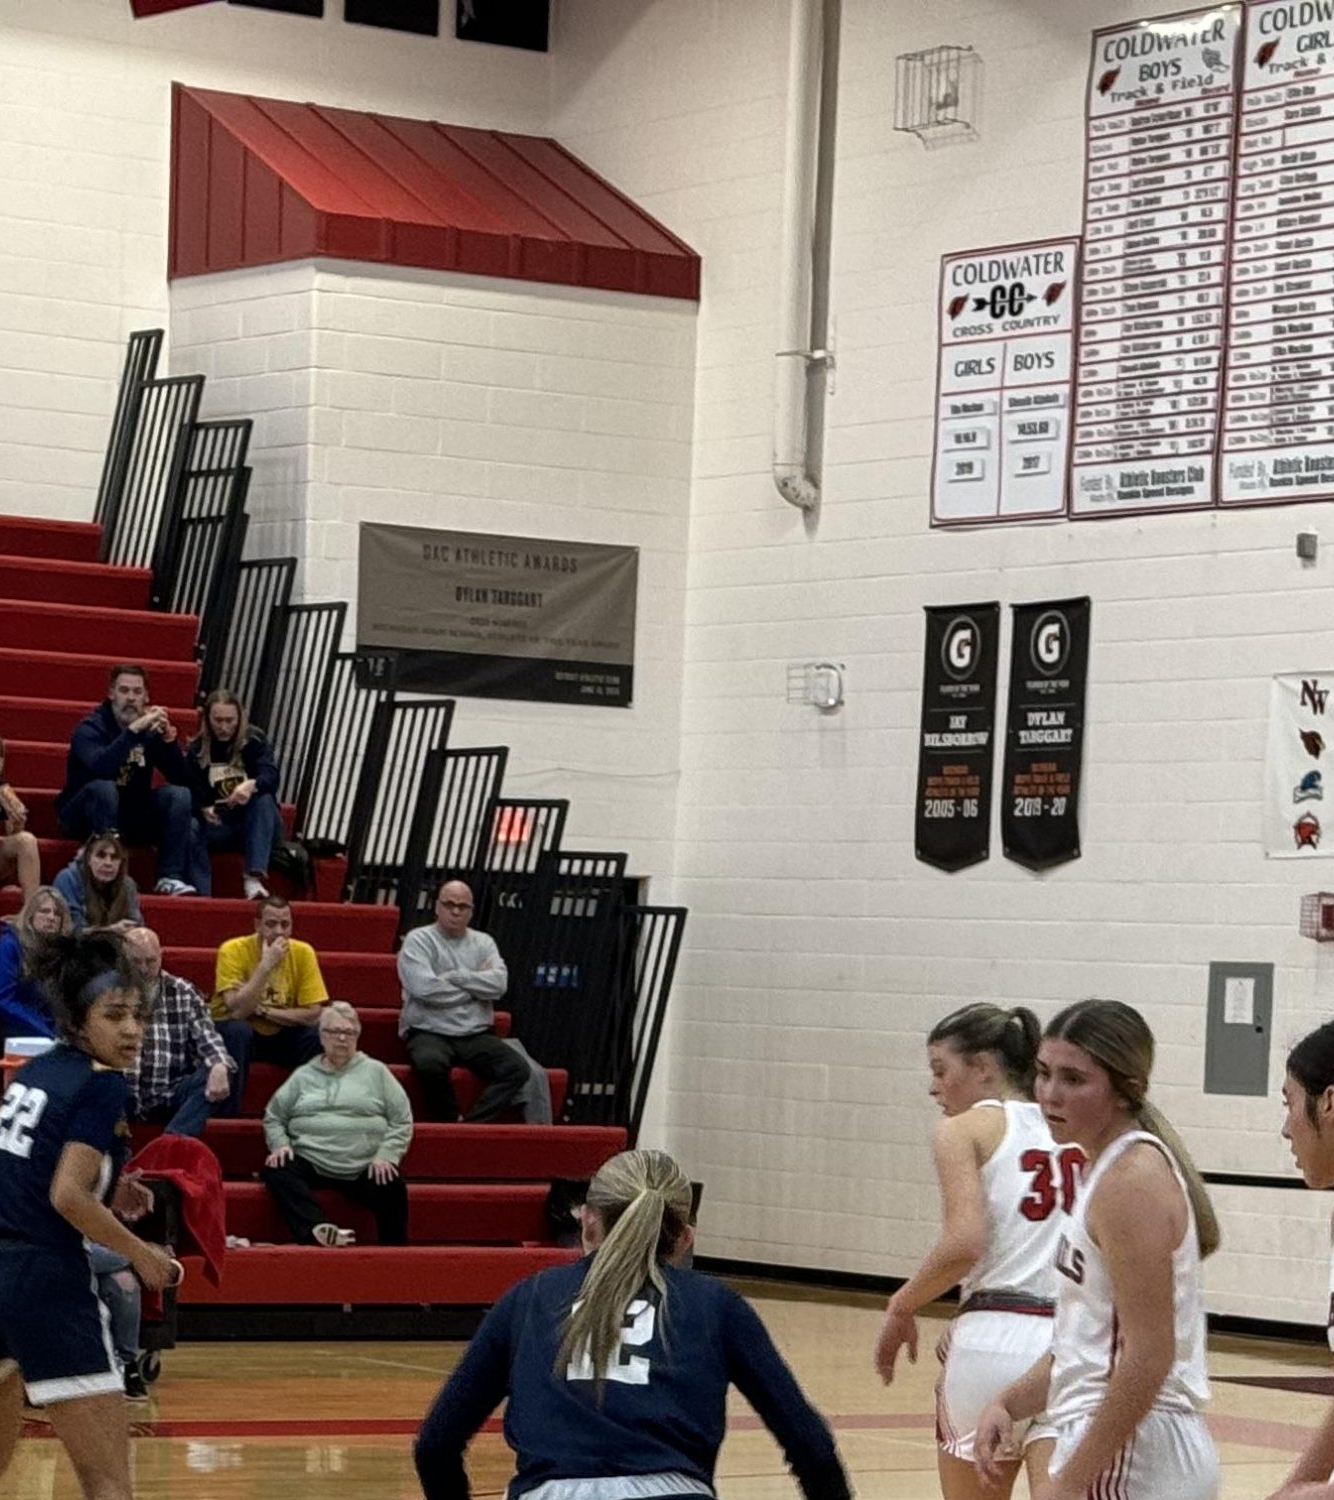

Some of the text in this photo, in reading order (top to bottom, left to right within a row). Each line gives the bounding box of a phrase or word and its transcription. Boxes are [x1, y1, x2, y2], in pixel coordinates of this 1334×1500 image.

[1139, 58, 1182, 82] BOYS
[1172, 74, 1214, 90] Field
[952, 251, 1065, 286] COLDWATER
[952, 315, 1060, 338] CROSS COUNTRY
[954, 357, 996, 377] GIRLS
[1013, 351, 1055, 371] BOYS
[455, 547, 518, 568] ATHLETIC
[524, 554, 579, 574] AWARDS
[950, 629, 972, 668] G
[1038, 624, 1061, 664] G
[1027, 711, 1066, 726] DYLAN
